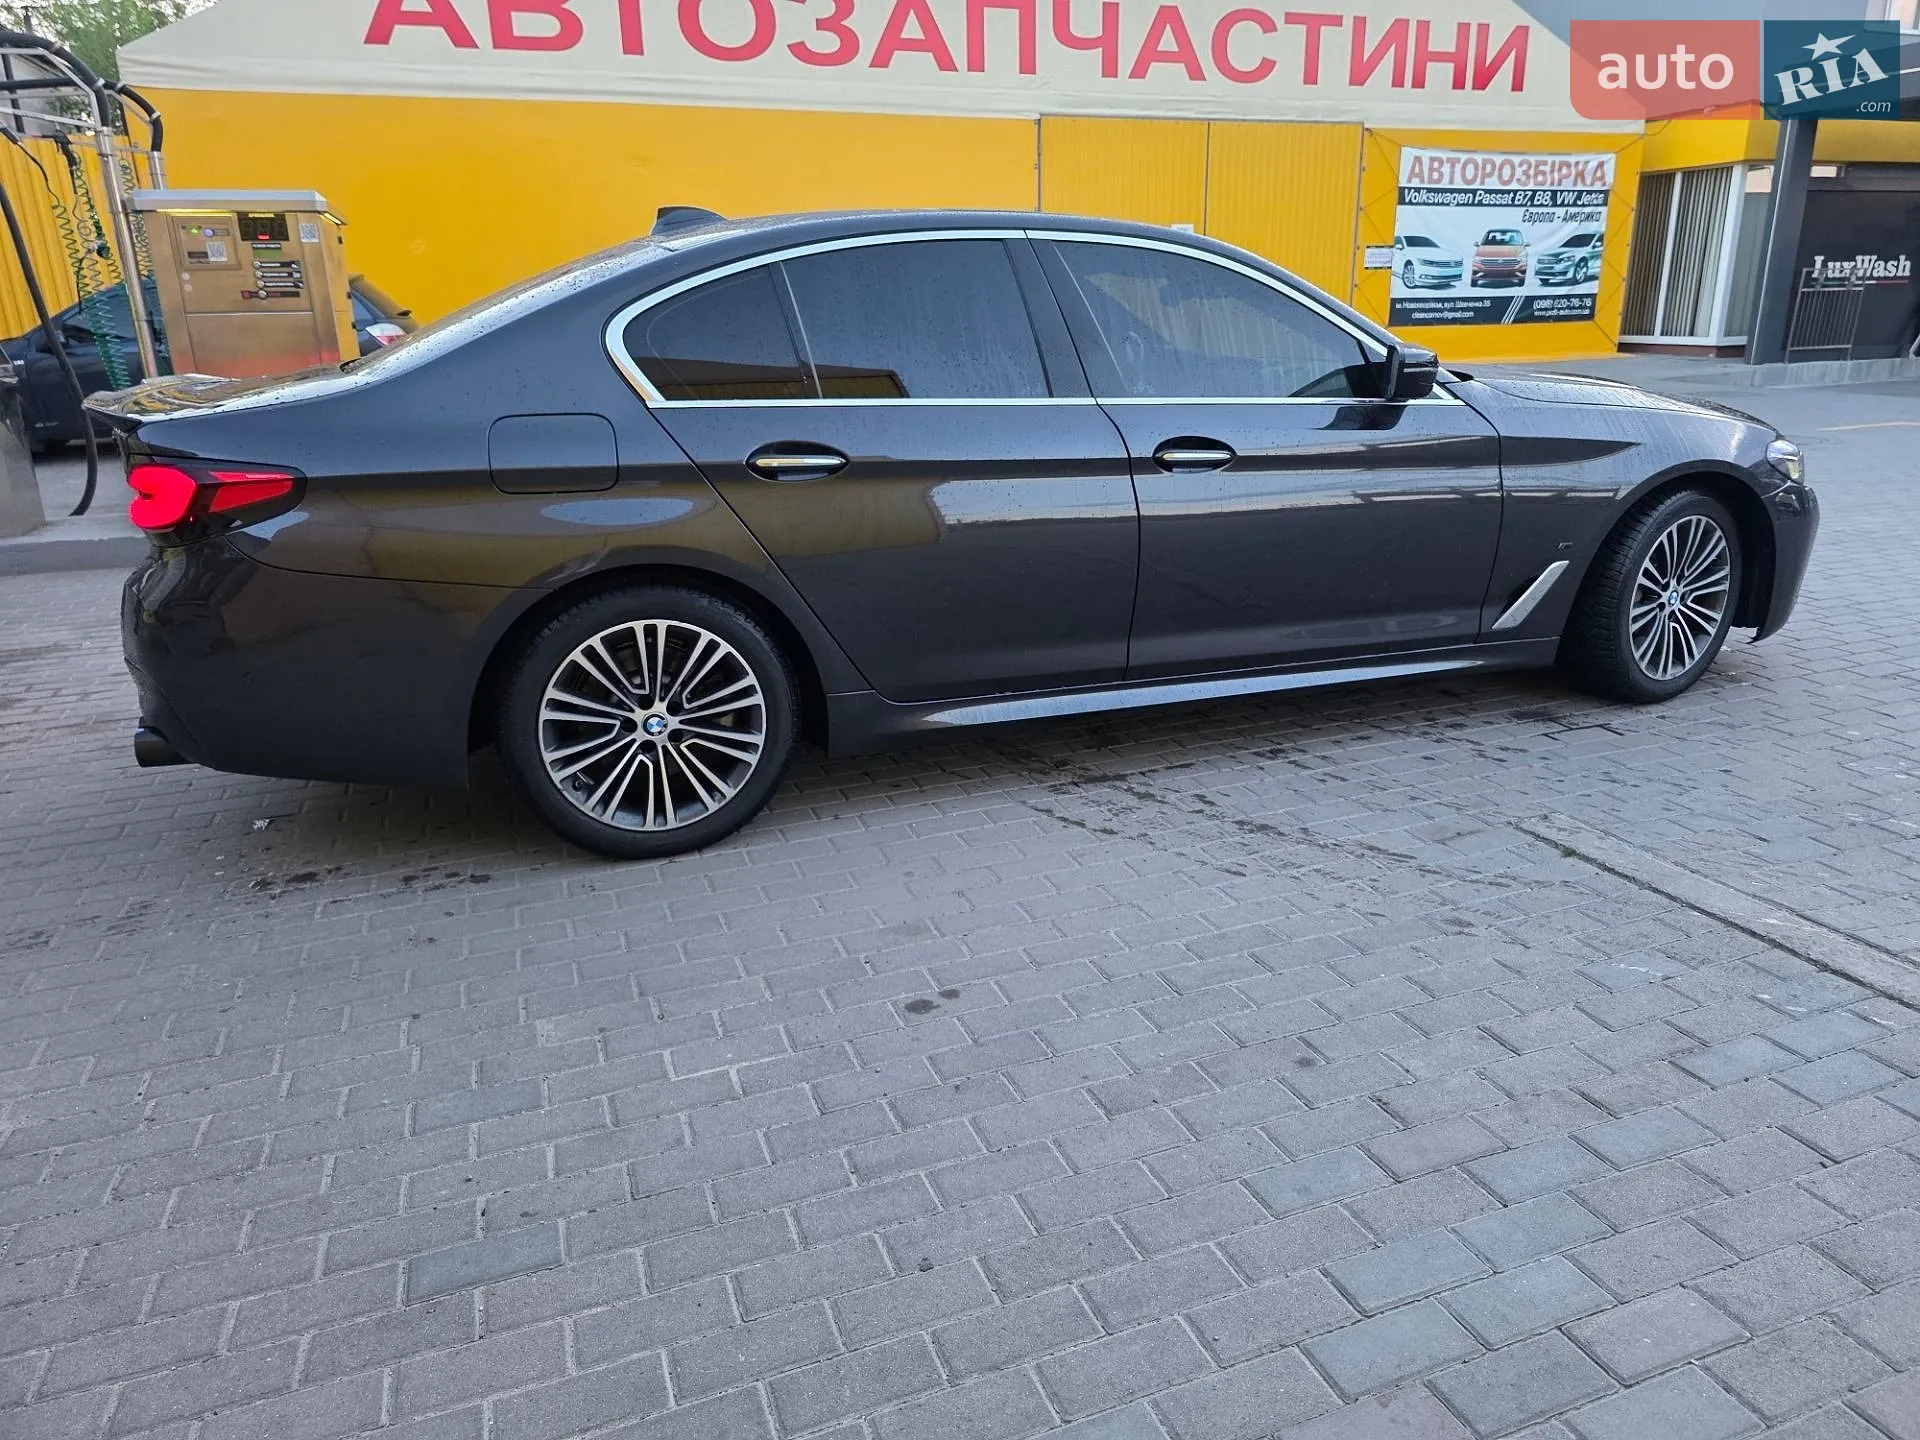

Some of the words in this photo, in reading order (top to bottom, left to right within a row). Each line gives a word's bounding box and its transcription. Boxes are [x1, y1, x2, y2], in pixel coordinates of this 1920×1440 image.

[363, 0, 1531, 93] АВТОЗАПЧАСТИНИ
[1406, 155, 1607, 187] АВТОРОЗБІРКА
[1404, 189, 1473, 206] Volkswagen
[1474, 190, 1513, 205] Passat
[1555, 191, 1577, 205] VW
[1577, 191, 1604, 206] Jetta
[1522, 209, 1555, 225] Європа
[1561, 209, 1601, 225] Америка
[1811, 254, 1911, 278] LuxWash
